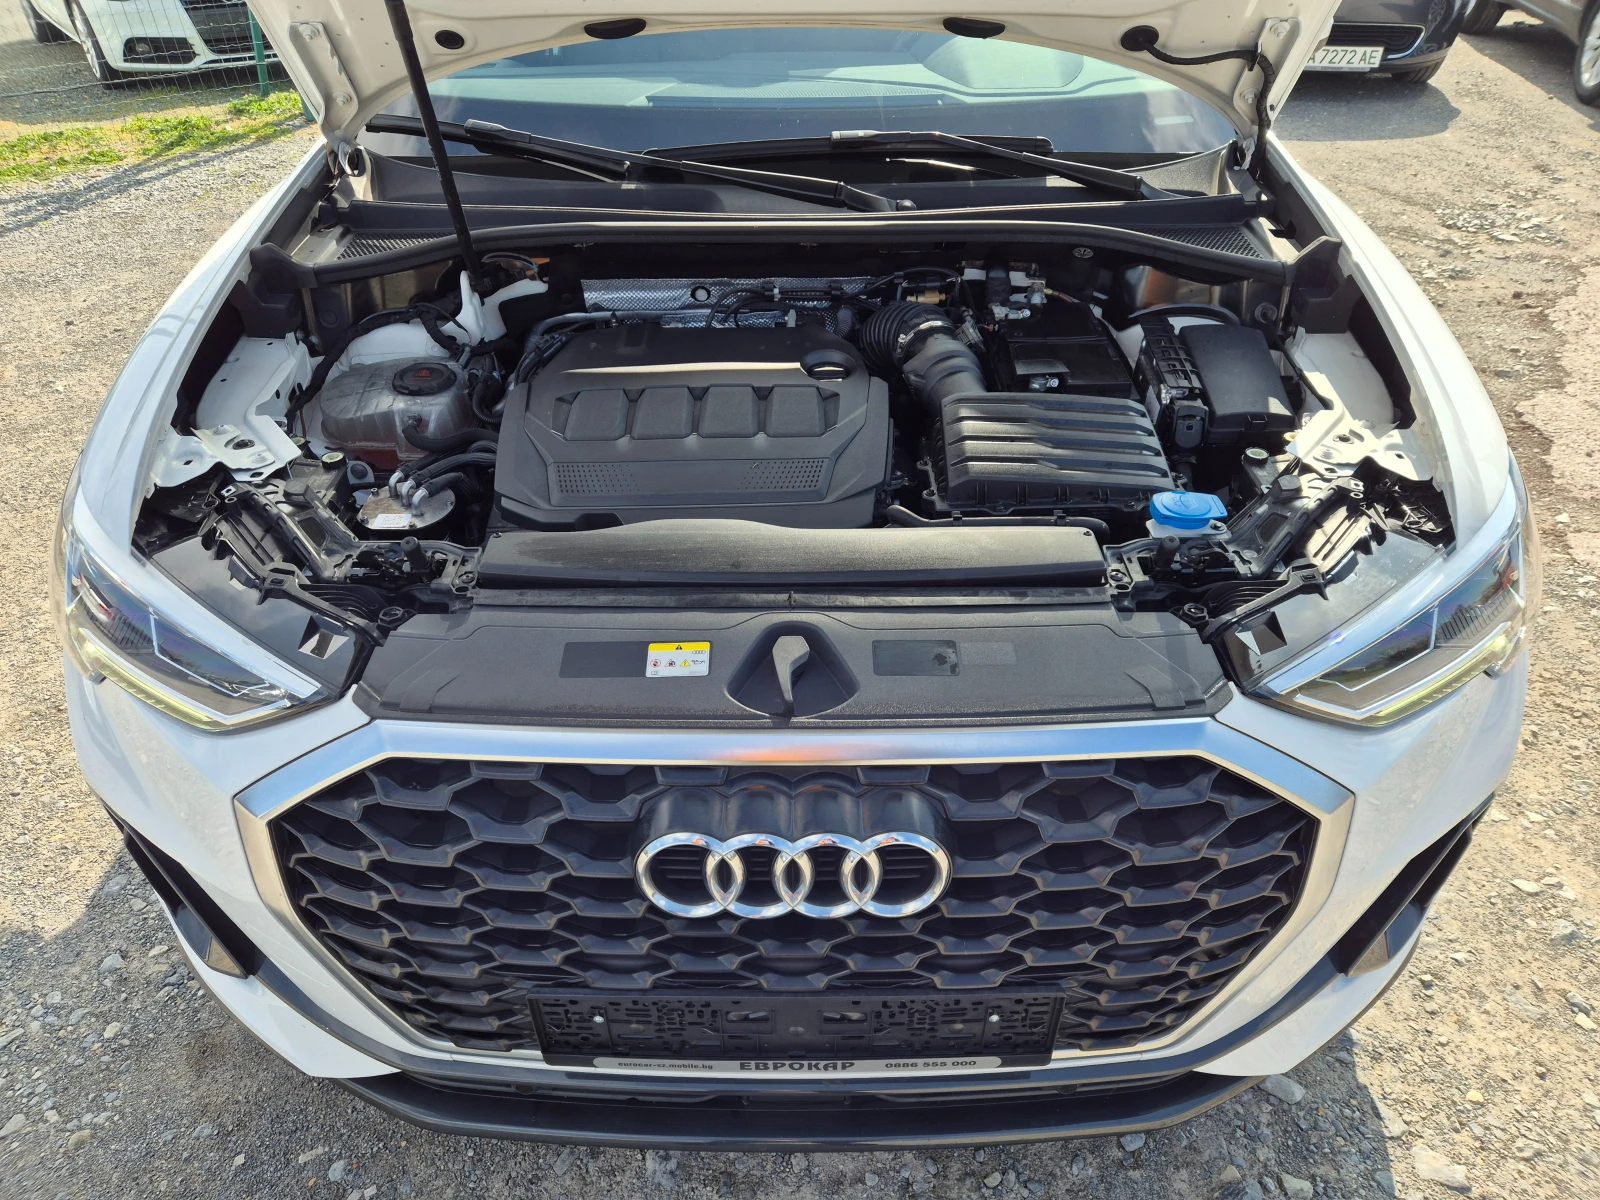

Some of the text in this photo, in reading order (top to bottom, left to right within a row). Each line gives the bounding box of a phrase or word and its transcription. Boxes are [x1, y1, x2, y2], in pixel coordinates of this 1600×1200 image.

[1319, 49, 1357, 64] 7272
[1358, 50, 1379, 65] AE
[618, 1061, 713, 1070] eurocar-sz.mobile.bg
[739, 1061, 855, 1071] ЕВРОКАР
